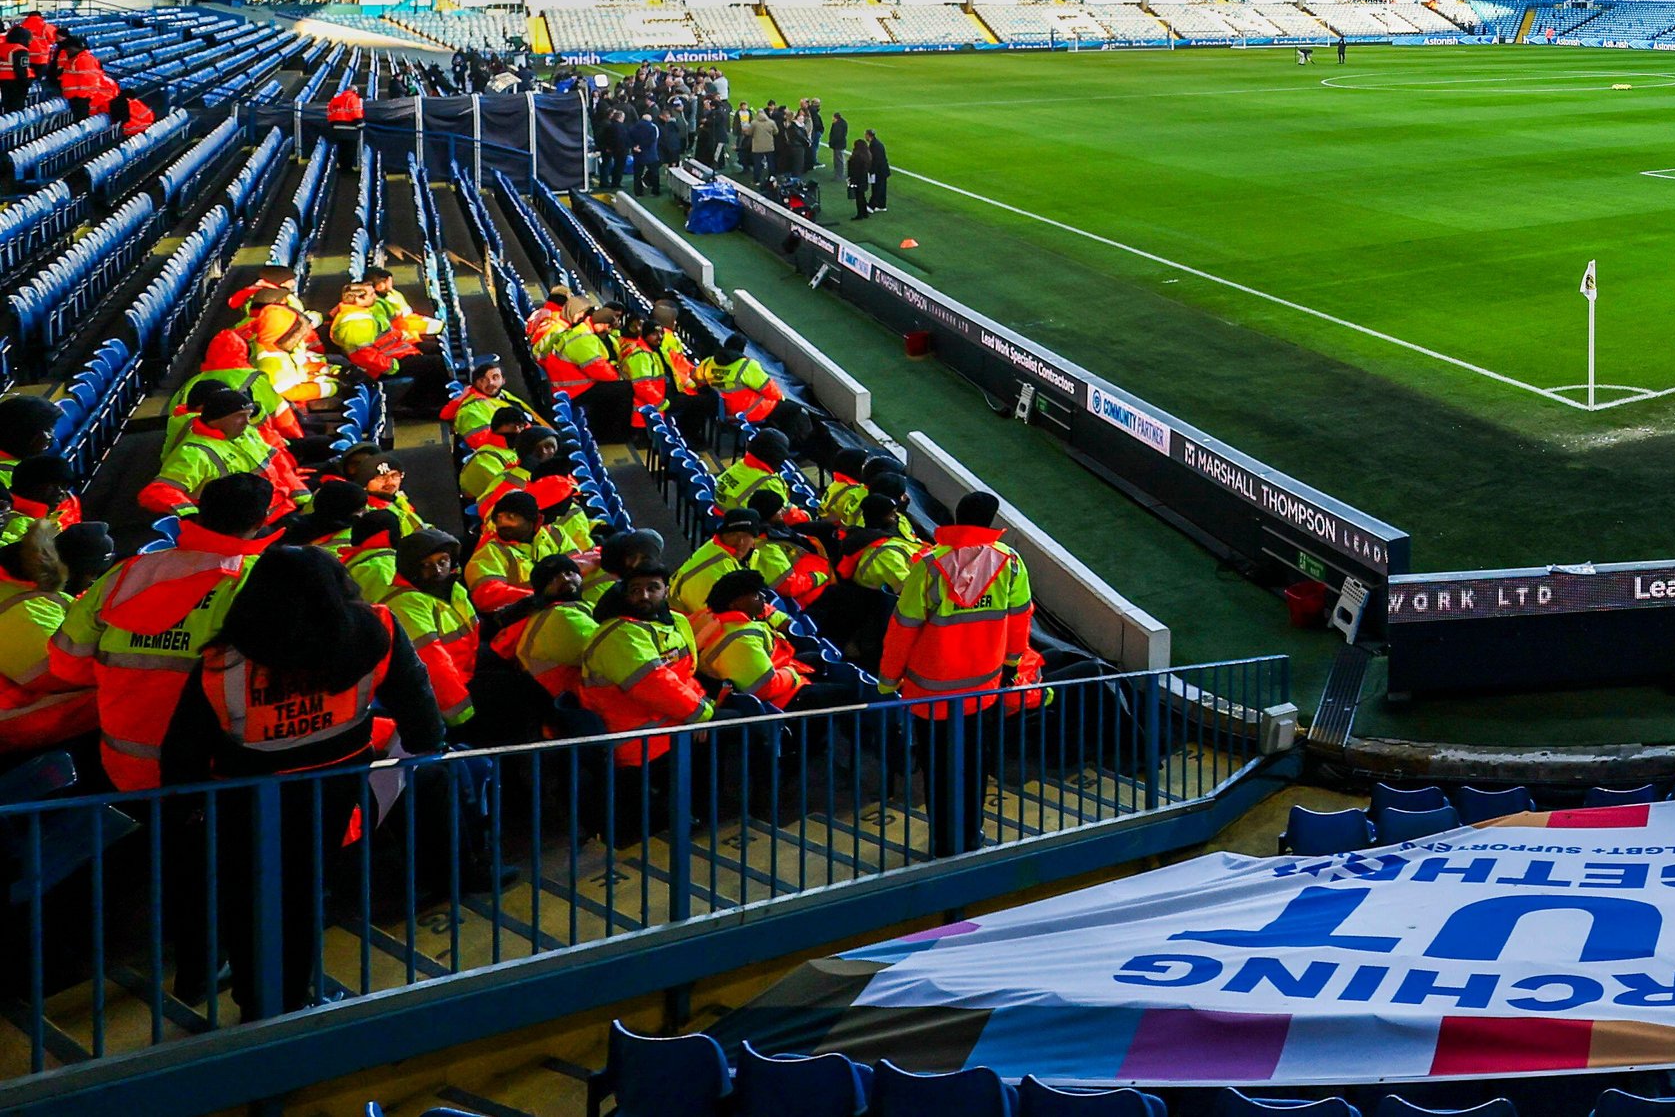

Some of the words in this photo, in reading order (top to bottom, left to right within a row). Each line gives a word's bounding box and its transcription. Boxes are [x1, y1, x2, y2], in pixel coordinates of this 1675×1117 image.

[1423, 37, 1458, 46] Astonish
[1556, 37, 1580, 47] Astonish
[664, 50, 728, 63] Astonish
[880, 271, 902, 297] MARSHALL
[904, 285, 928, 311] THOMPSON
[981, 330, 995, 349] Lead
[994, 338, 1010, 359] Work
[1010, 346, 1038, 374] Specialist
[1037, 362, 1075, 395] Contractors
[1103, 399, 1137, 432] COMMUNITY
[1137, 415, 1164, 449] PARTNER
[1197, 449, 1257, 501] MARSHALL
[1260, 483, 1336, 543] THOMPSON
[1344, 528, 1389, 564] LEAD
[1498, 585, 1553, 607] LTD
[129, 631, 191, 651] MEMBER
[274, 696, 324, 722] TEAM
[263, 711, 334, 741] LEADER
